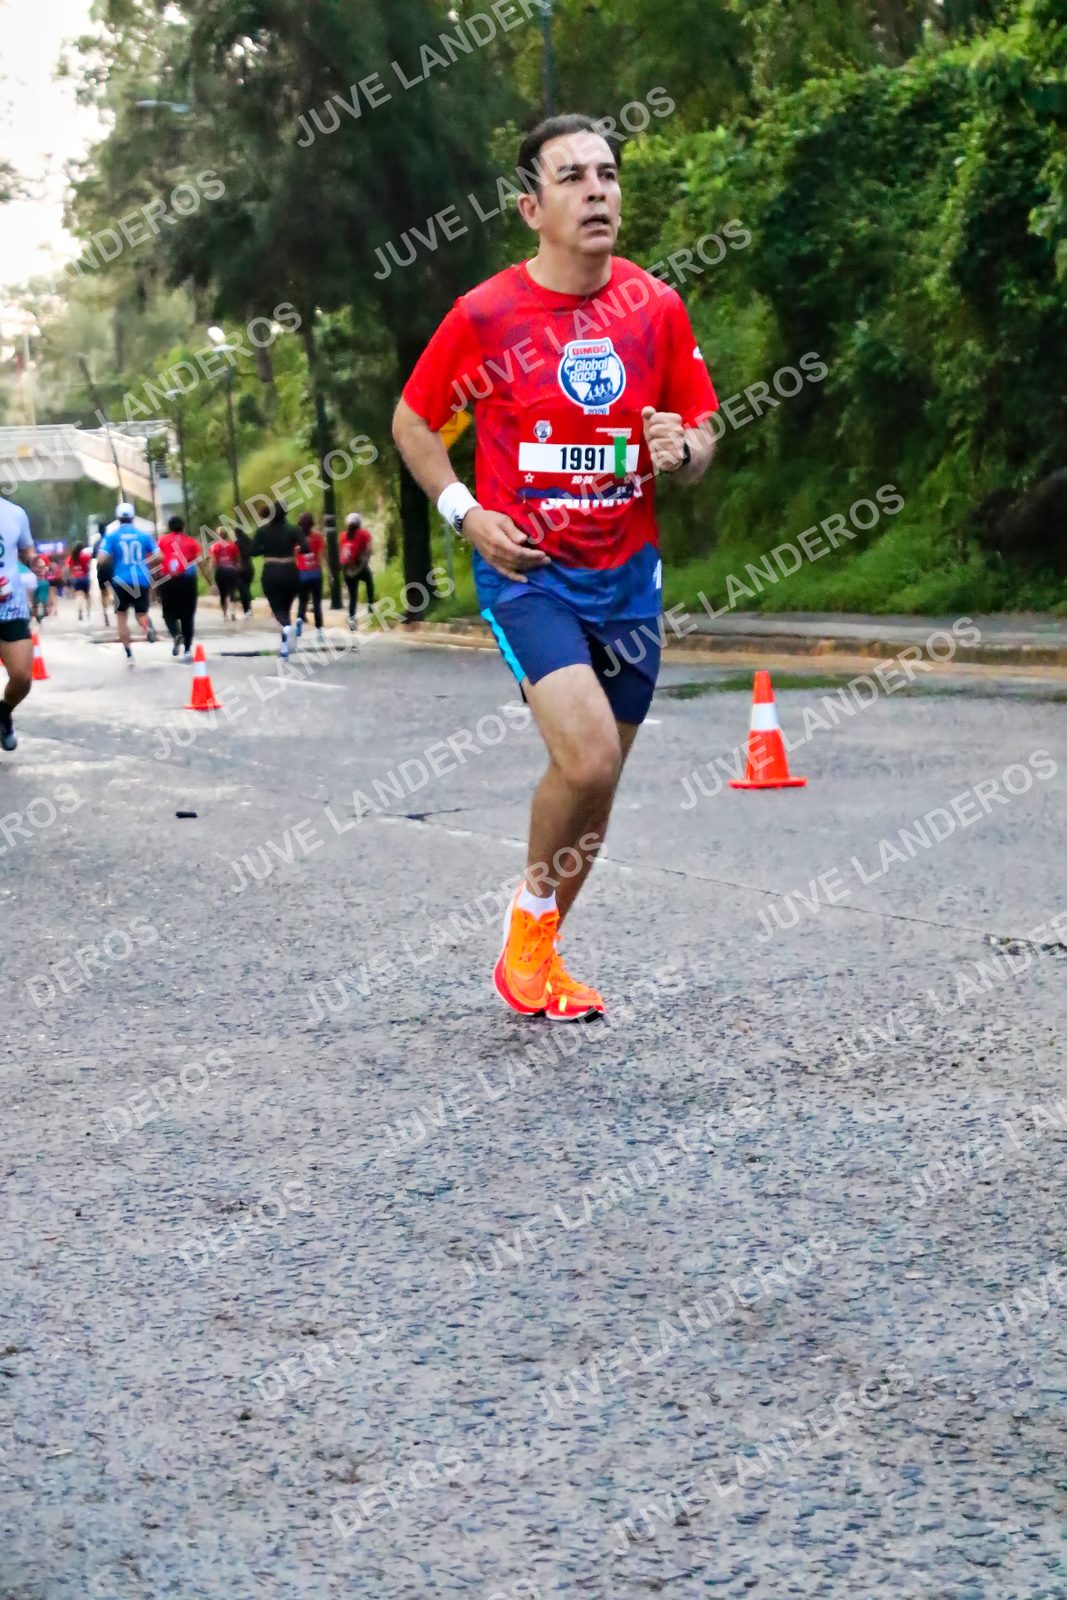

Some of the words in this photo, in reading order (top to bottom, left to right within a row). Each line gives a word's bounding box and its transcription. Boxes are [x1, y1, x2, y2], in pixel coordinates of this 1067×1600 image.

[574, 358, 609, 372] Global
[569, 370, 597, 382] Race
[560, 447, 605, 470] 1991
